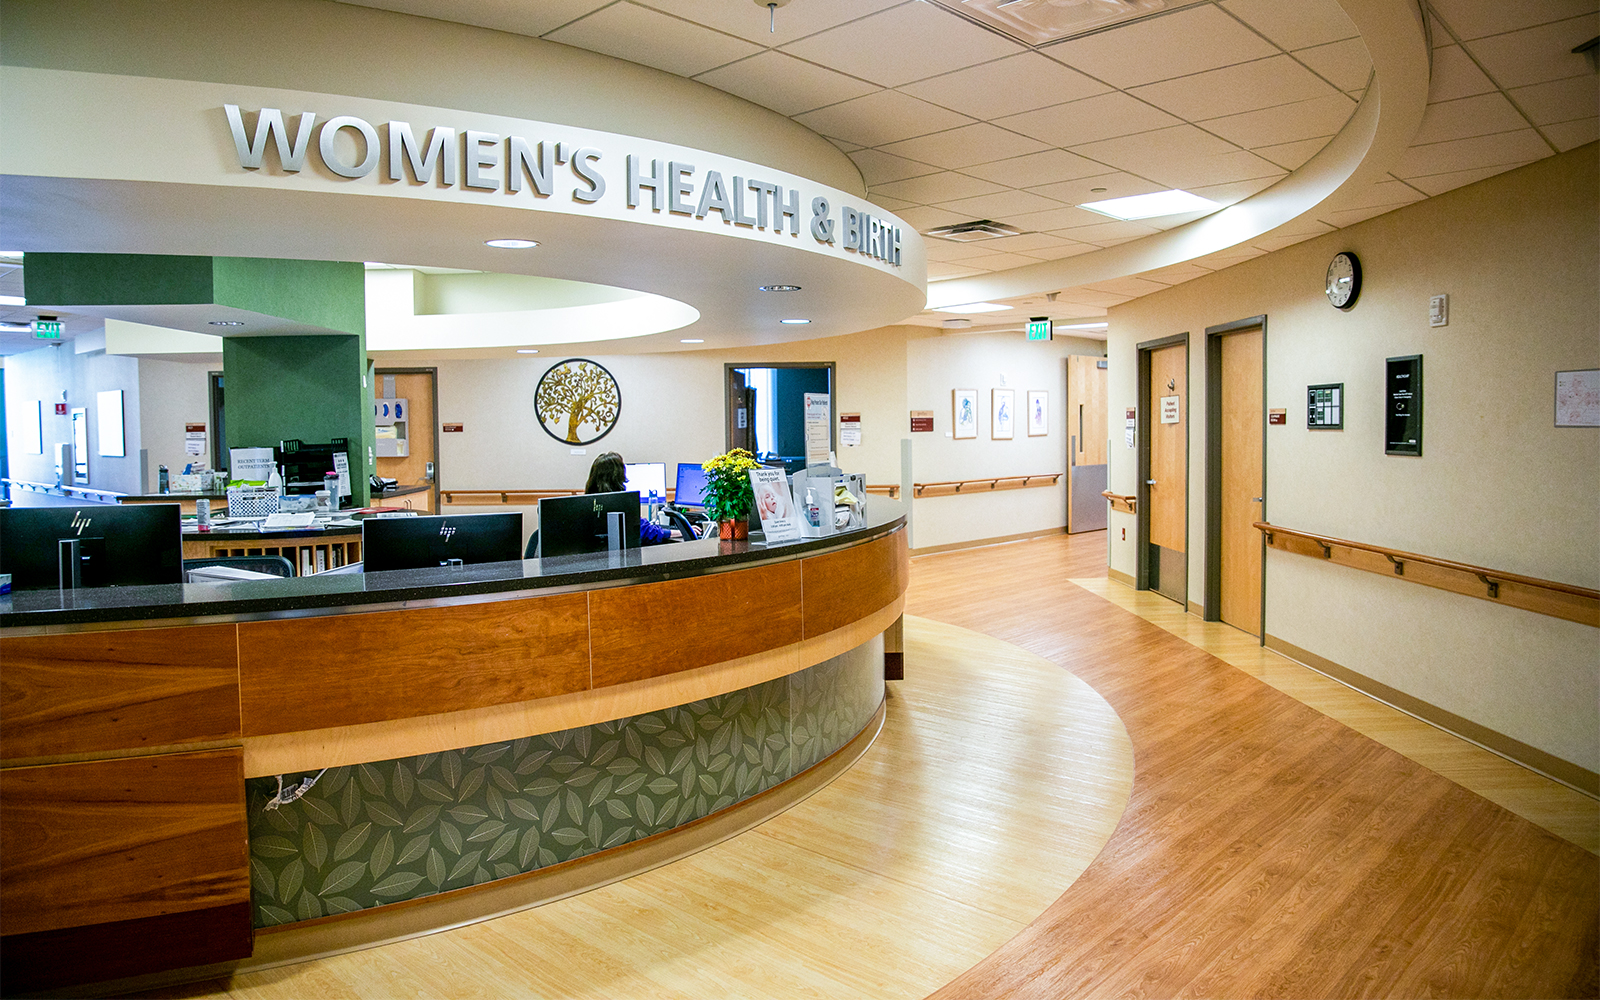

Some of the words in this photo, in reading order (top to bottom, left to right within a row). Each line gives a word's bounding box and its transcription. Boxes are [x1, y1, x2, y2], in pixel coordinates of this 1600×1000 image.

[223, 103, 607, 202] WOMEN'S
[626, 153, 799, 236] HEALTH
[810, 195, 835, 243] &
[842, 205, 902, 266] BIRTH
[36, 321, 61, 339] EXIT
[1029, 322, 1048, 340] EXIT
